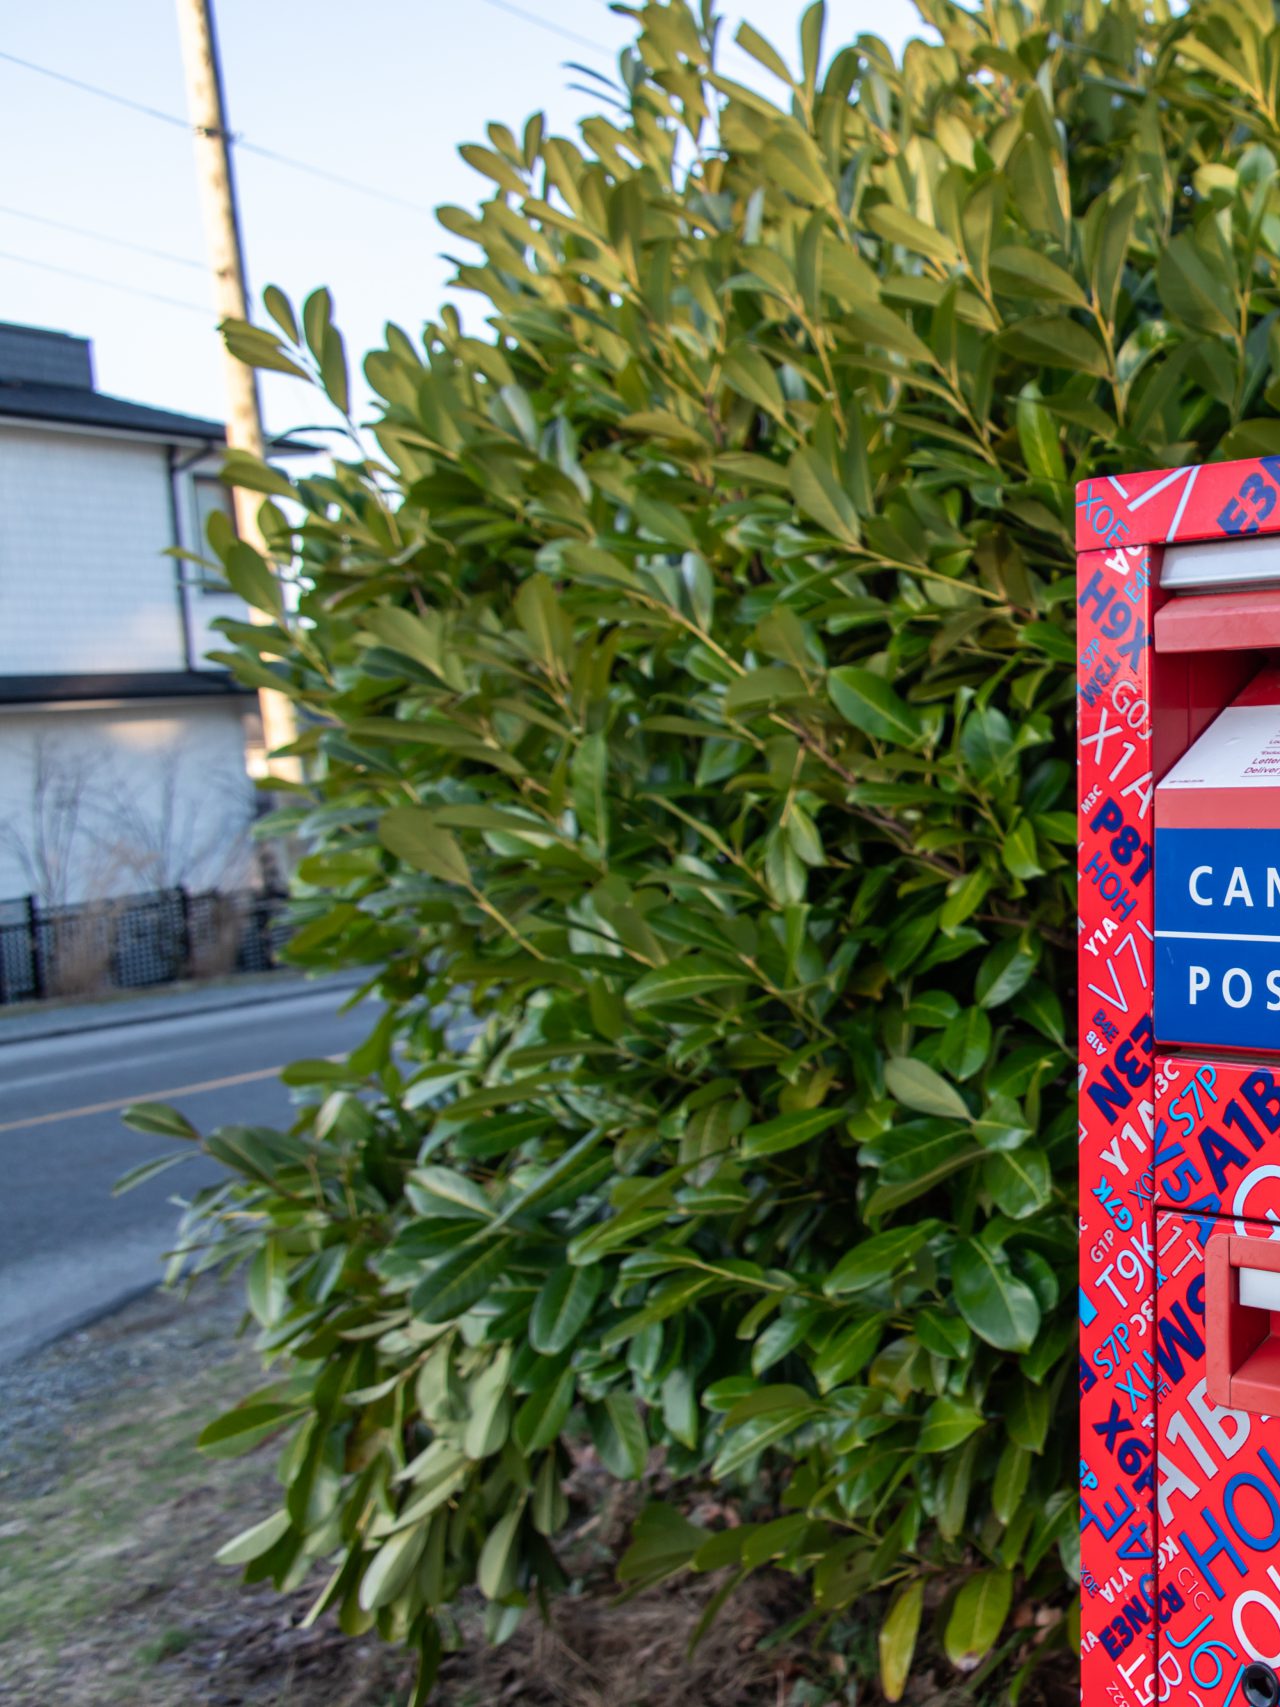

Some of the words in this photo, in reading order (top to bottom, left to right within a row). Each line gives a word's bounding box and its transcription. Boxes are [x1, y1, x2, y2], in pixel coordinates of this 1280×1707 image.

[1078, 569, 1153, 675] H9X
[1080, 783, 1104, 815] M3C
[1083, 917, 1119, 957] Y1A
[1092, 1007, 1119, 1044] B4E
[1168, 1064, 1218, 1137] S7P
[1090, 1228, 1114, 1263] G1P
[1092, 1321, 1131, 1379] S7P
